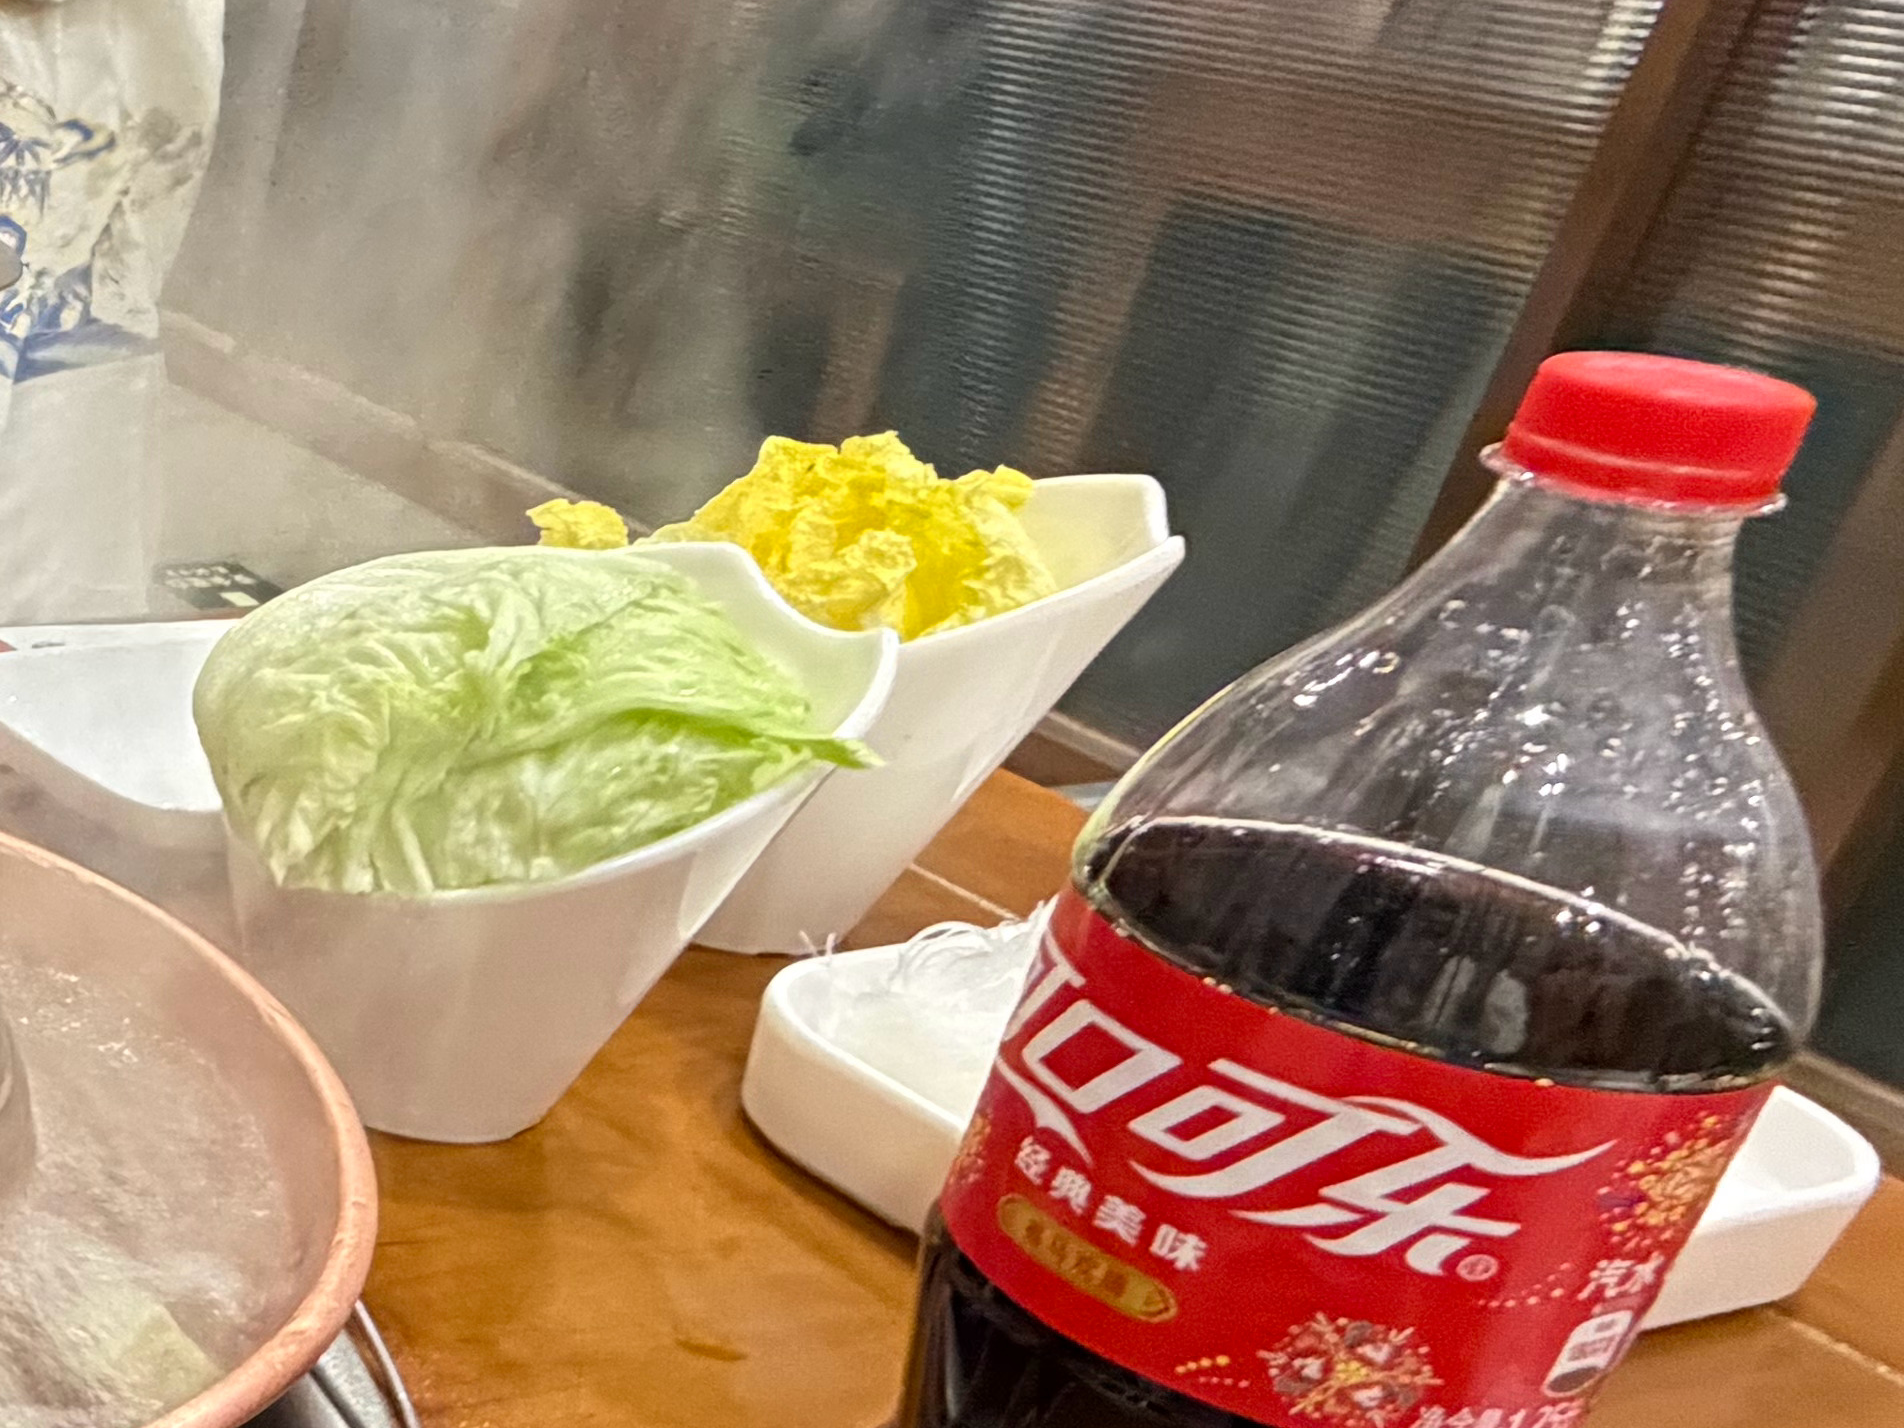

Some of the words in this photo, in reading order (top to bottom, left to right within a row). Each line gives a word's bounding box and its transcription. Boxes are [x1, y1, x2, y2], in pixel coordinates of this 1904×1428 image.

[1014, 1135, 1209, 1272] 经典美味
[1576, 1251, 1666, 1301] 汽水
